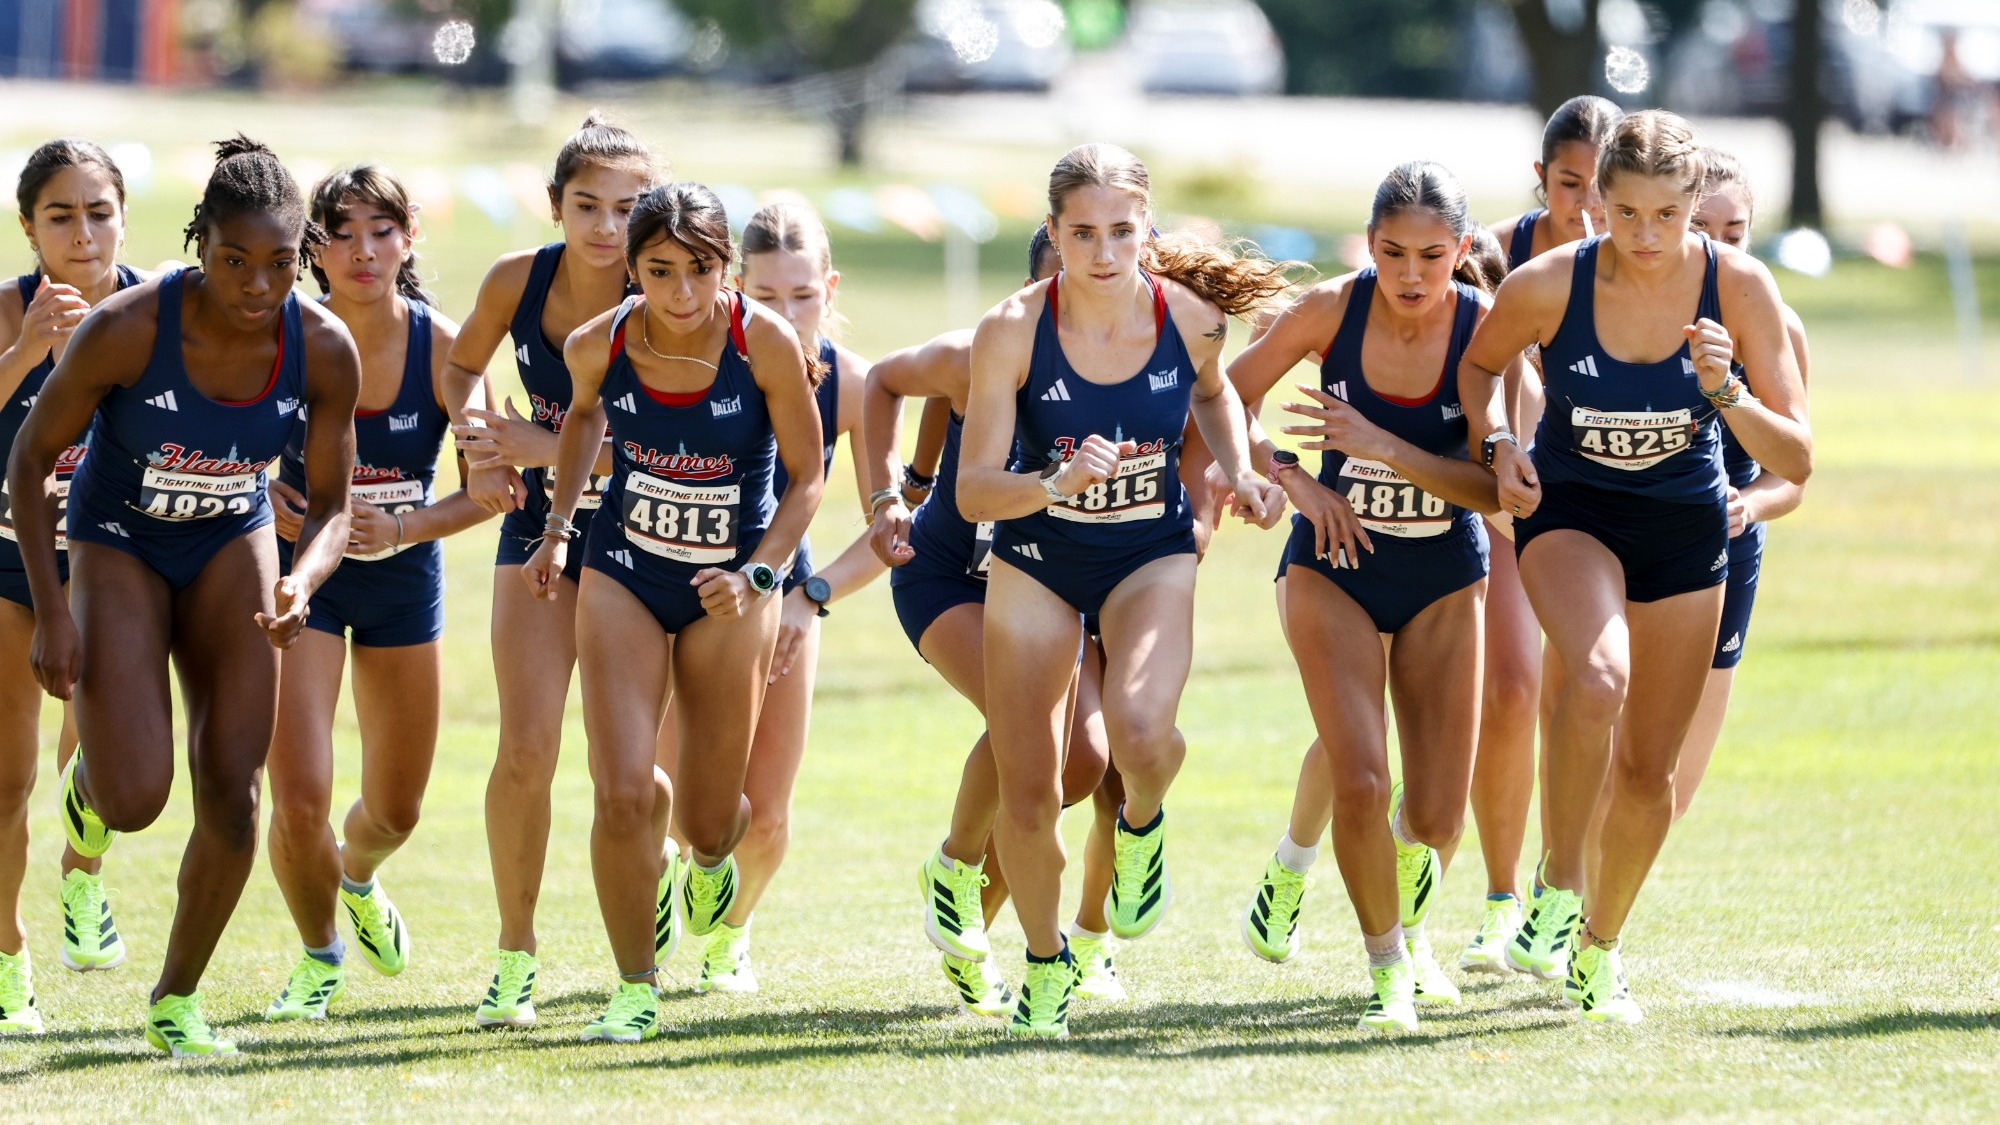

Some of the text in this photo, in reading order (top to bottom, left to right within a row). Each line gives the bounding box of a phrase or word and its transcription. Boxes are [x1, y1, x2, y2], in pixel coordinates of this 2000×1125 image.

[1148, 366, 1178, 391] VALLEY
[710, 394, 742, 416] VALLEY
[389, 411, 419, 431] VALLEY
[1583, 415, 1641, 427] FIGHTING
[1643, 416, 1680, 427] ILLINI
[1055, 436, 1164, 462] Fes
[1580, 426, 1687, 458] 4825
[625, 440, 733, 479] Flames
[1120, 459, 1155, 474] ILLINI
[154, 476, 247, 492] FIGHTING ILLINI
[379, 488, 413, 500] ILLINI
[636, 480, 730, 502] FIGHTING ILLINI
[629, 498, 731, 545] 4813
